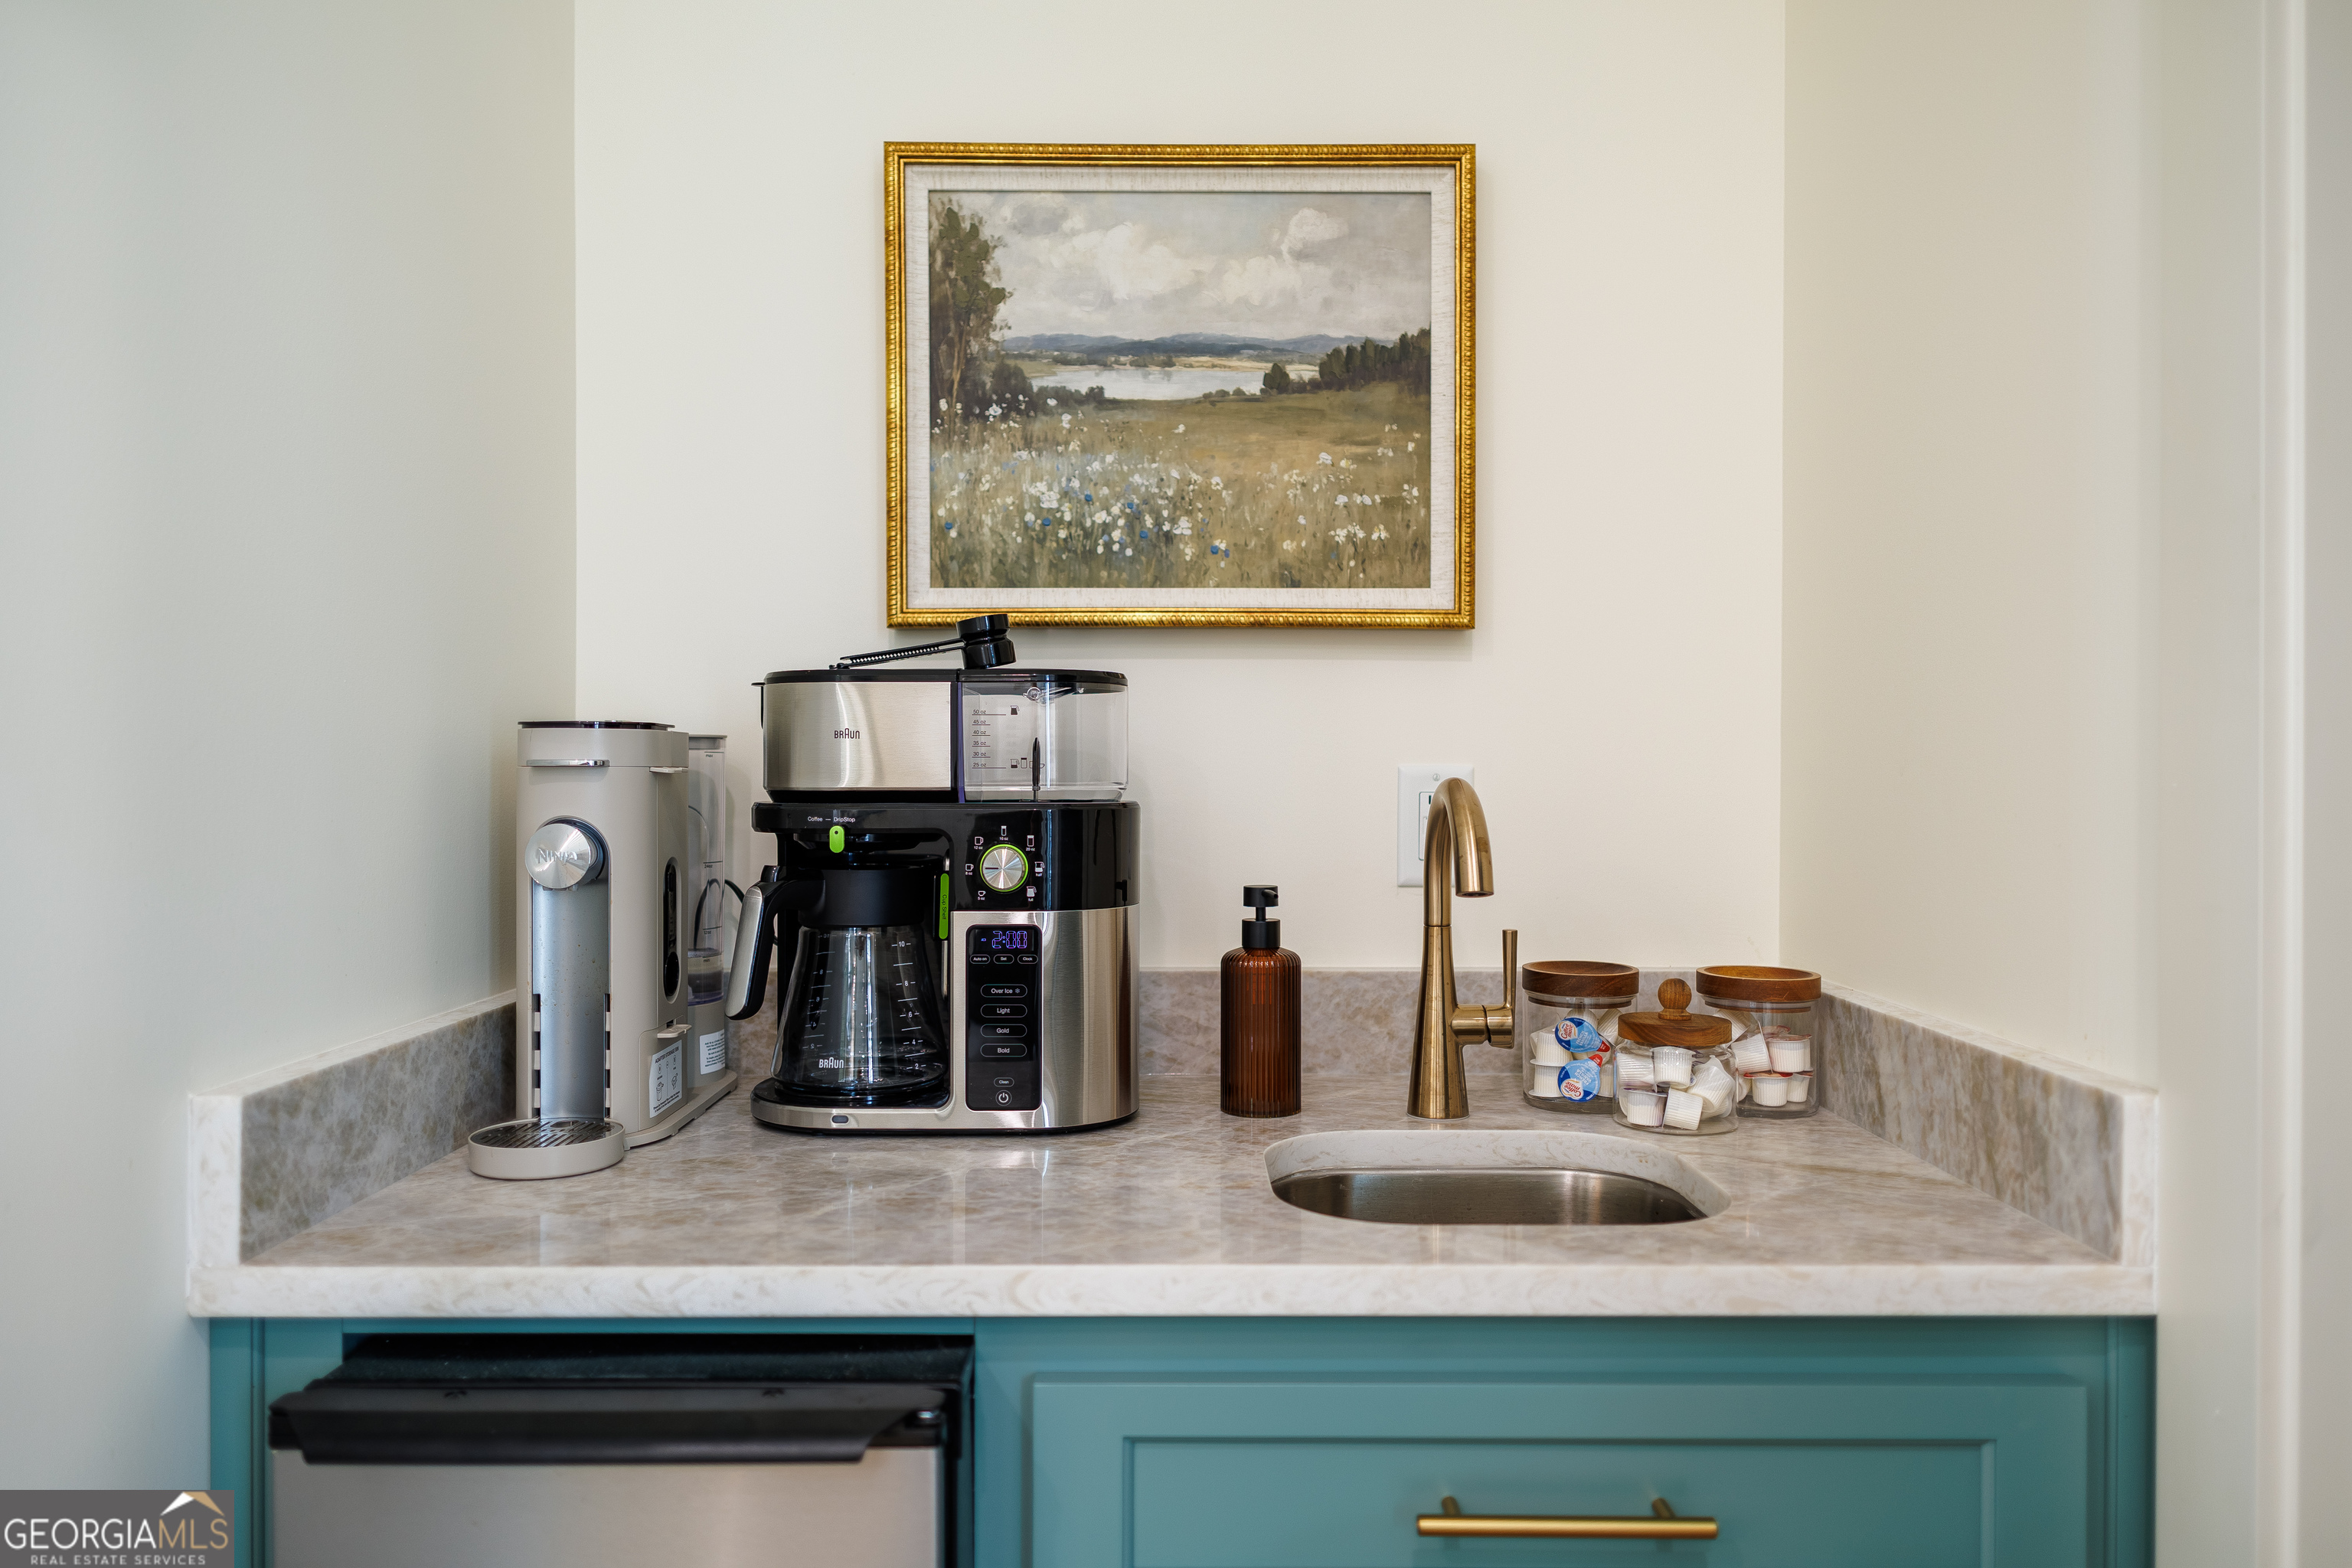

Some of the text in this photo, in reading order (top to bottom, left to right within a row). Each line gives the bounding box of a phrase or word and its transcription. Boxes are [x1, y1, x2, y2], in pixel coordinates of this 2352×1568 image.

[835, 728, 860, 739] BRAUN
[992, 931, 1027, 949] 2:00
[819, 1057, 844, 1068] BRAUN
[1564, 1085, 1581, 1097] Coffee
